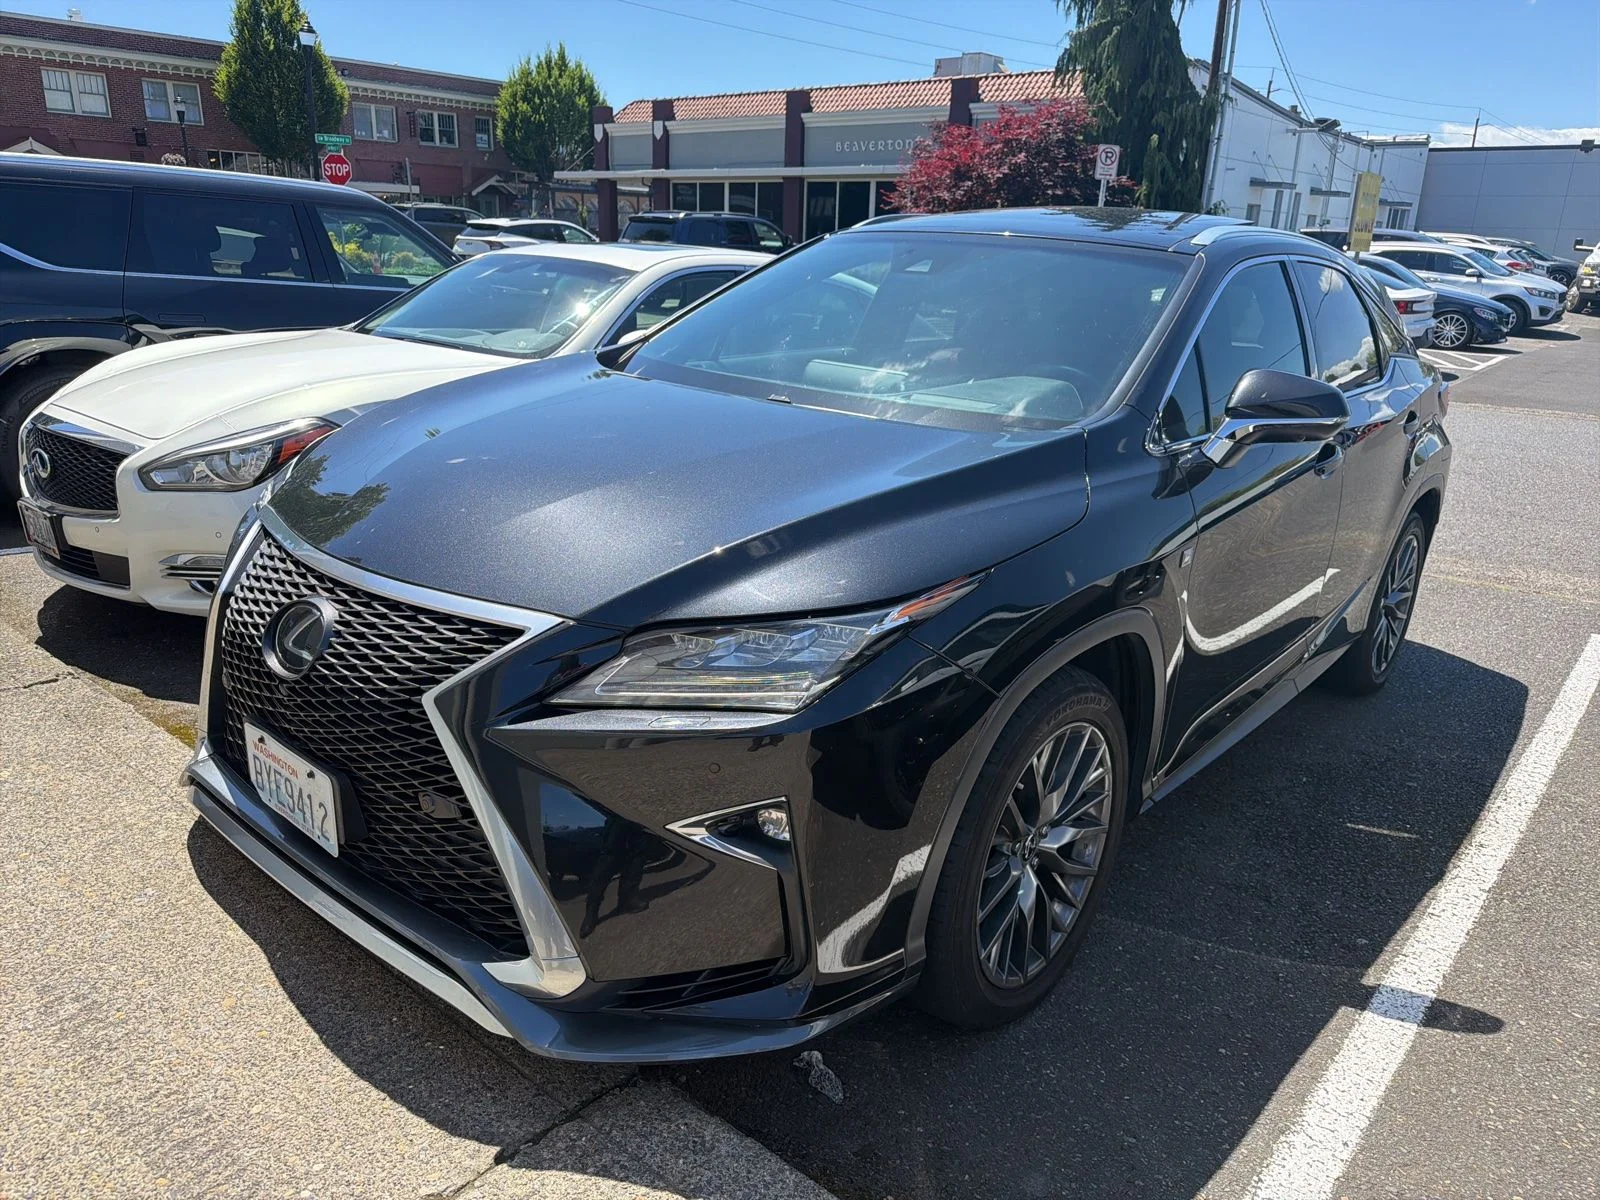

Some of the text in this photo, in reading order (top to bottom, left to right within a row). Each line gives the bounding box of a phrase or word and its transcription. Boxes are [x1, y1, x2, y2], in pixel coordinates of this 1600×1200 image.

[324, 135, 345, 143] Broadway
[835, 139, 914, 152] BEAVERTON
[324, 163, 350, 176] STOP
[1046, 695, 1103, 727] YOKOHAMA
[252, 741, 298, 780] WASHINGTON
[252, 754, 330, 843] BYE9412
